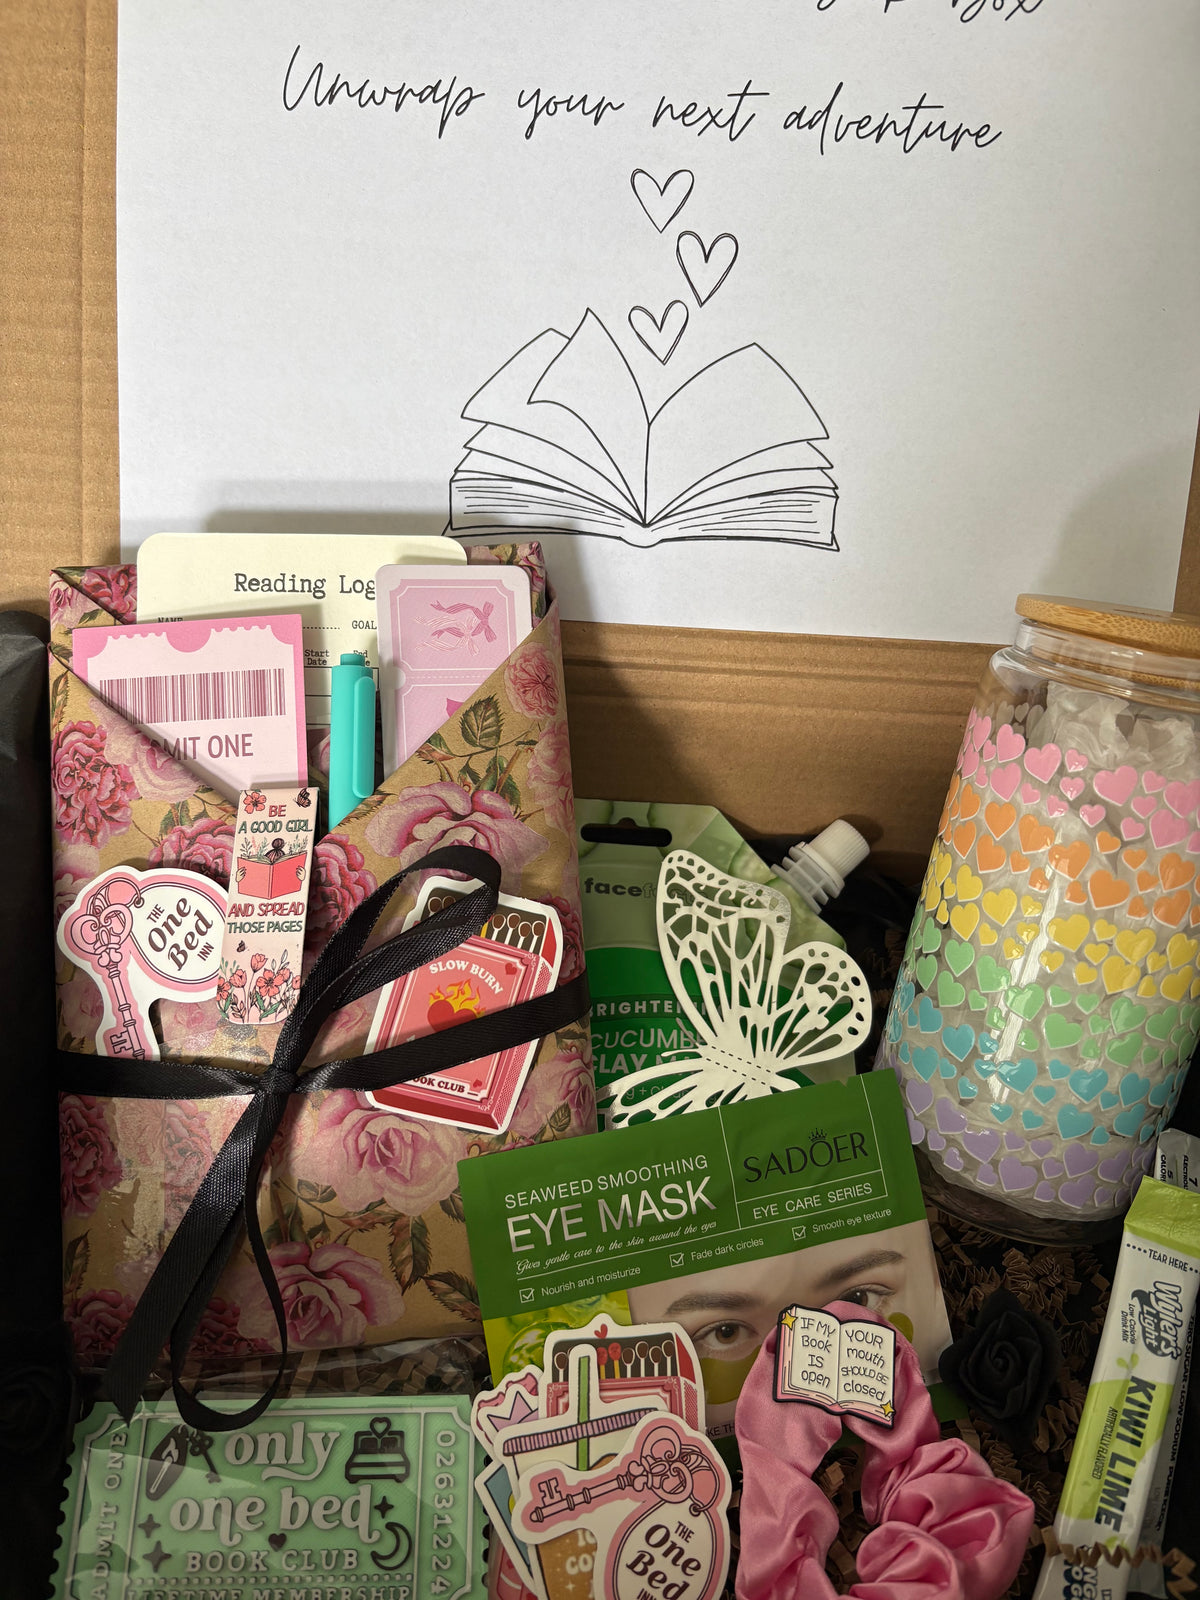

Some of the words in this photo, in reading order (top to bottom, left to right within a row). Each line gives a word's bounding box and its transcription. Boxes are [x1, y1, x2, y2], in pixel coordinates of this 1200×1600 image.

[283, 46, 486, 139] Unwrap
[517, 86, 625, 140] your
[653, 80, 770, 141] next
[784, 82, 1003, 155] adventure
[233, 573, 327, 599] Reading
[339, 574, 377, 599] Log
[351, 620, 378, 630] GOAL
[304, 649, 330, 657] Start
[307, 658, 328, 666] Date
[150, 737, 200, 761] MIT
[208, 733, 253, 759] ONE
[268, 804, 287, 818] BE
[238, 821, 249, 834] A
[250, 820, 283, 834] GOOD
[285, 819, 313, 832] GIRL
[146, 903, 165, 923] THE
[228, 902, 255, 918] AND
[257, 902, 305, 917] SPREAD
[148, 897, 192, 953] One
[227, 921, 265, 934] THOSE
[266, 920, 303, 933] PAGES
[167, 910, 214, 971] Bed
[197, 943, 215, 962] INN
[429, 960, 468, 974] SLOW
[470, 961, 503, 994] BURN
[437, 1080, 465, 1093] CLUB
[743, 1131, 869, 1184] SADOER
[505, 1179, 594, 1209] SEAWEED
[598, 1154, 708, 1191] SMOOTHING
[1167, 1170, 1173, 1180] 5
[1188, 1177, 1198, 1188] 7
[753, 1203, 779, 1220] EYE
[785, 1192, 822, 1213] CARE
[827, 1183, 873, 1203] SERIES
[507, 1203, 587, 1253] EYE
[598, 1176, 717, 1233] MASK
[812, 1219, 845, 1233] Smooth
[847, 1215, 862, 1227] eye
[863, 1208, 892, 1223] texture
[516, 1259, 541, 1275] Gives
[544, 1251, 570, 1270] gentle
[574, 1248, 592, 1258] care
[596, 1245, 605, 1254] to
[608, 1240, 623, 1251] the
[626, 1236, 645, 1248] skin
[649, 1229, 680, 1243] around
[684, 1224, 698, 1235] the
[701, 1221, 717, 1233] eyes
[691, 1249, 713, 1261] Fade
[715, 1244, 734, 1256] dark
[736, 1237, 764, 1250] circles
[1148, 1248, 1167, 1264] TEAR
[1168, 1257, 1188, 1273] HERE
[541, 1281, 576, 1297] Nourish
[578, 1276, 595, 1289] and
[597, 1266, 641, 1283] moisturize
[1121, 1310, 1129, 1330] Drink
[1128, 1303, 1136, 1319] Low
[1148, 1280, 1184, 1360] Wyler's
[800, 1316, 815, 1329] IF
[816, 1320, 836, 1338] MY
[1129, 1318, 1137, 1345] Calorie
[1139, 1304, 1159, 1348] Light
[801, 1335, 832, 1353] Book
[845, 1329, 884, 1349] YOUR
[808, 1353, 825, 1368] IS
[846, 1347, 885, 1369] mouth
[1182, 1344, 1192, 1382] SUGAR
[801, 1370, 831, 1388] open
[841, 1366, 876, 1379] SHOULD
[876, 1372, 889, 1385] BE
[843, 1380, 886, 1402] closed
[1116, 1375, 1156, 1447] KIWI
[1170, 1416, 1182, 1461] SODIUM
[225, 1421, 341, 1482] only
[1094, 1451, 1137, 1532] LIME
[91, 1502, 119, 1600] ADMIT
[105, 1432, 128, 1490] ONE
[168, 1494, 266, 1548] one
[280, 1484, 383, 1544] bed
[431, 1430, 457, 1594] 02631224
[674, 1520, 695, 1544] THE
[186, 1550, 270, 1573] BOOK
[282, 1548, 360, 1571] CLUB
[645, 1523, 702, 1577] One
[626, 1550, 690, 1600] Bed
